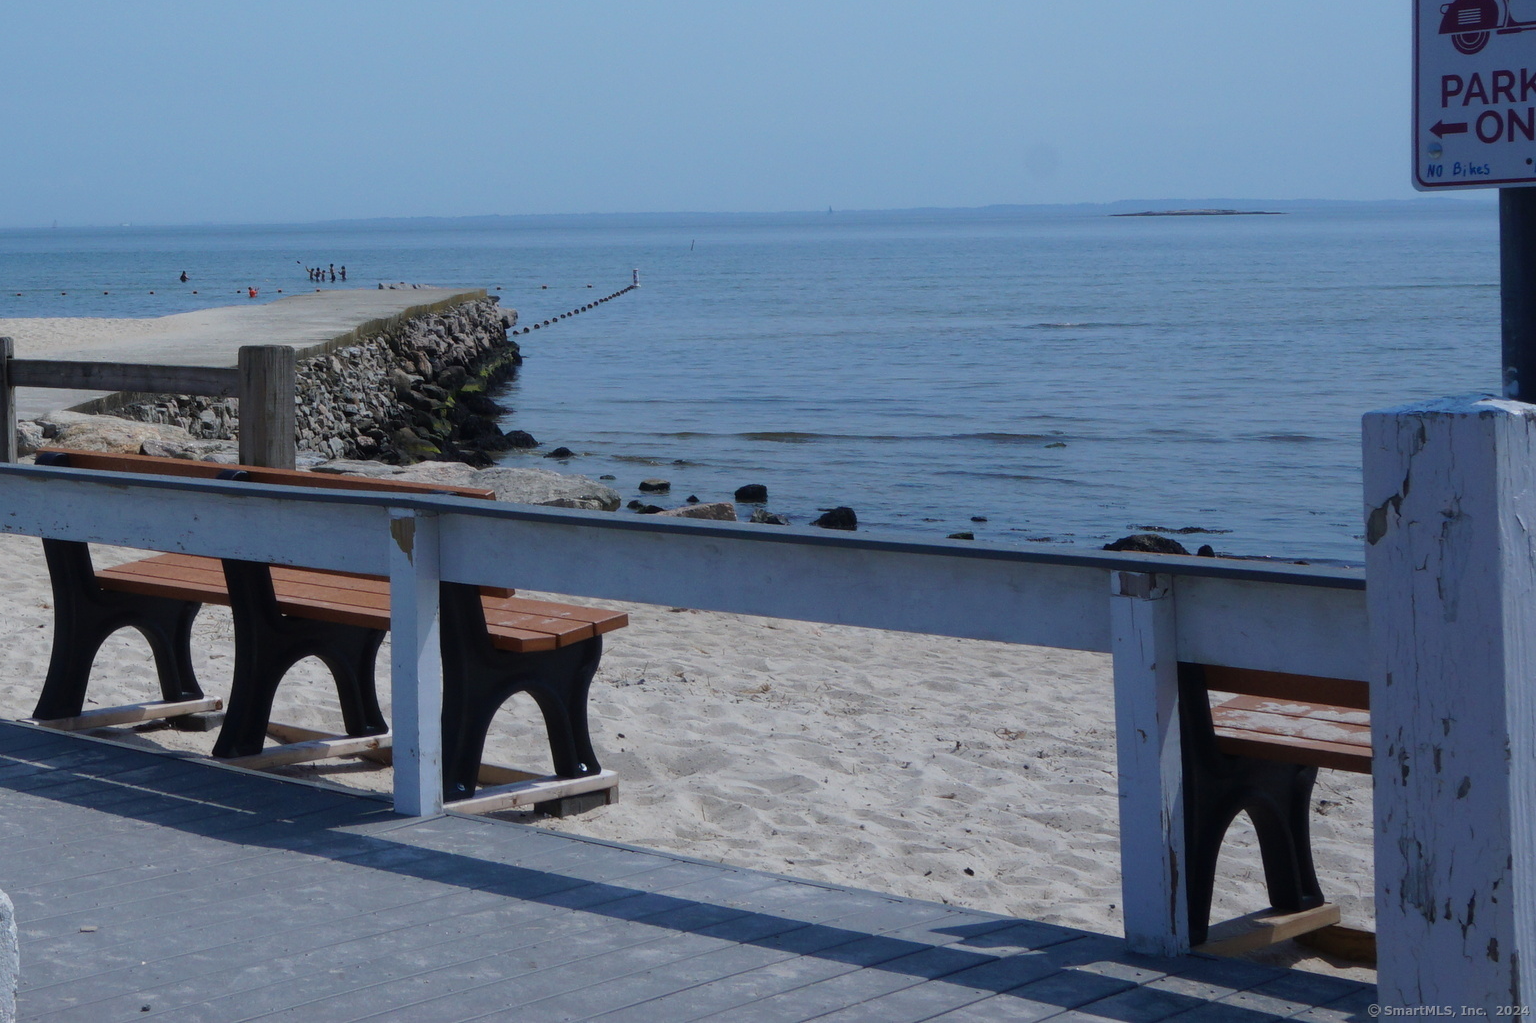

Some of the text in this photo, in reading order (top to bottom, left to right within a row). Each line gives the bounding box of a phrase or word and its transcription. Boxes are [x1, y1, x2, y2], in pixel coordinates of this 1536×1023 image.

[1441, 67, 1536, 108] PARK
[1475, 107, 1535, 144] ON
[1427, 161, 1491, 178] NO Bikes
